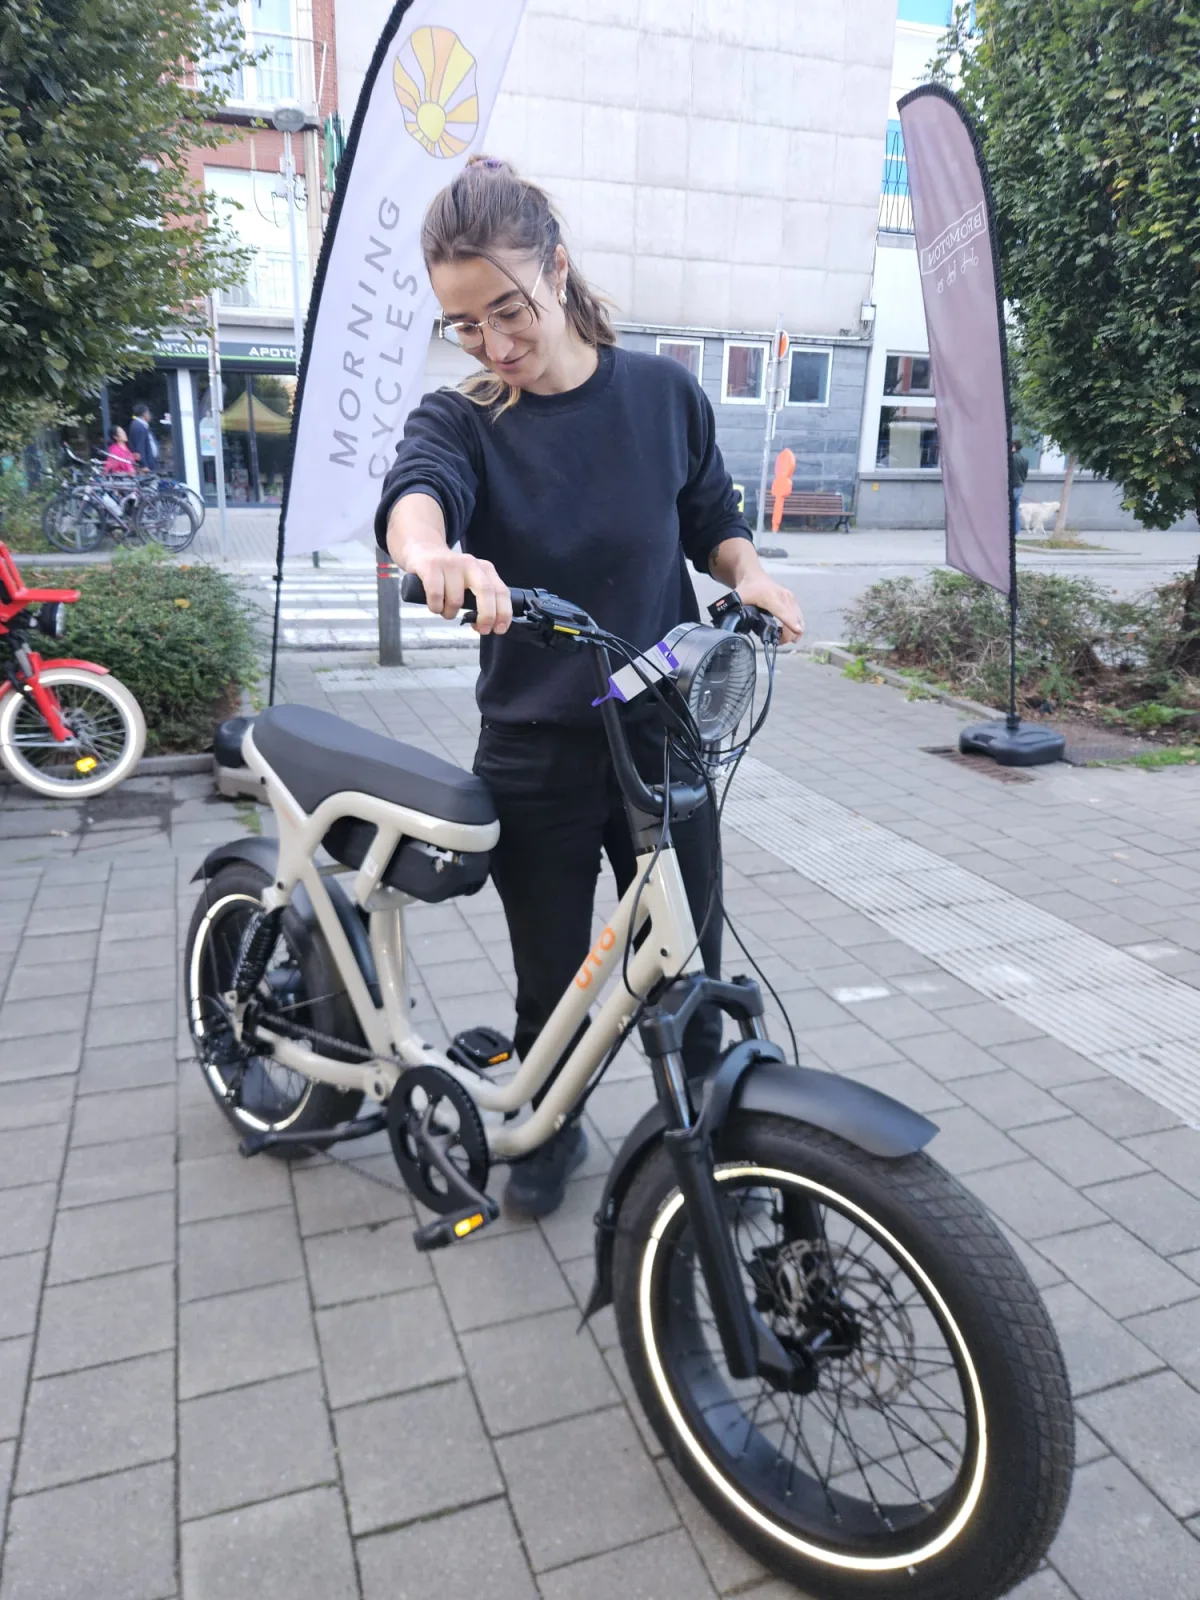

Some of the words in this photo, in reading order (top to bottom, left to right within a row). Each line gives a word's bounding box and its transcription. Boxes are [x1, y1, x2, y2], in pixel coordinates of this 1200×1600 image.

[329, 196, 400, 468] MORNING
[368, 269, 418, 479] CYCLES
[575, 927, 616, 990] UTO
